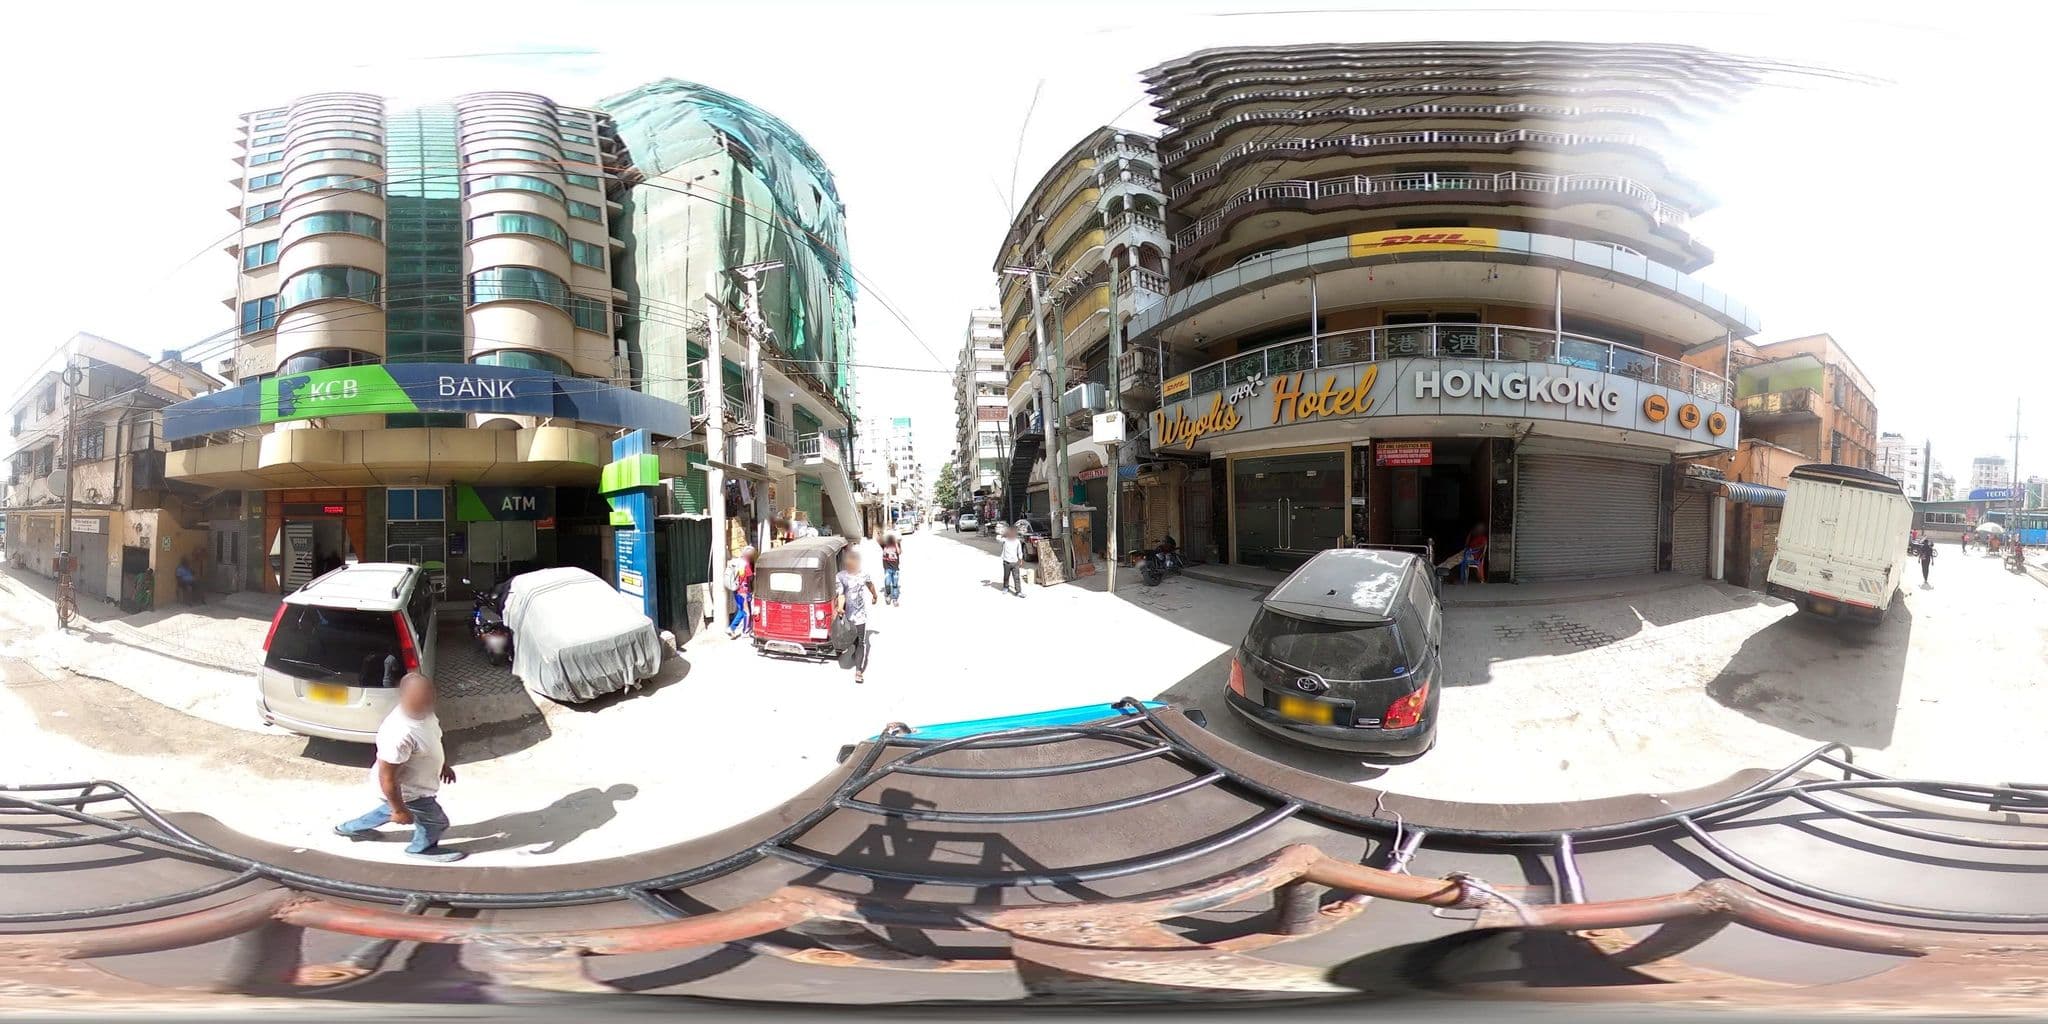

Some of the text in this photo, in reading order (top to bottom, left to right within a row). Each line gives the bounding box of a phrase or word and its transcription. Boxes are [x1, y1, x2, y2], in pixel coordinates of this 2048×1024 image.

[1380, 233, 1469, 247] DHL
[310, 375, 517, 402] KCB BANK
[1229, 381, 1259, 405] HK
[1415, 370, 1621, 412] HONGKONG
[1154, 364, 1379, 449] Wiyolis Hotel
[501, 496, 536, 511] ATM
